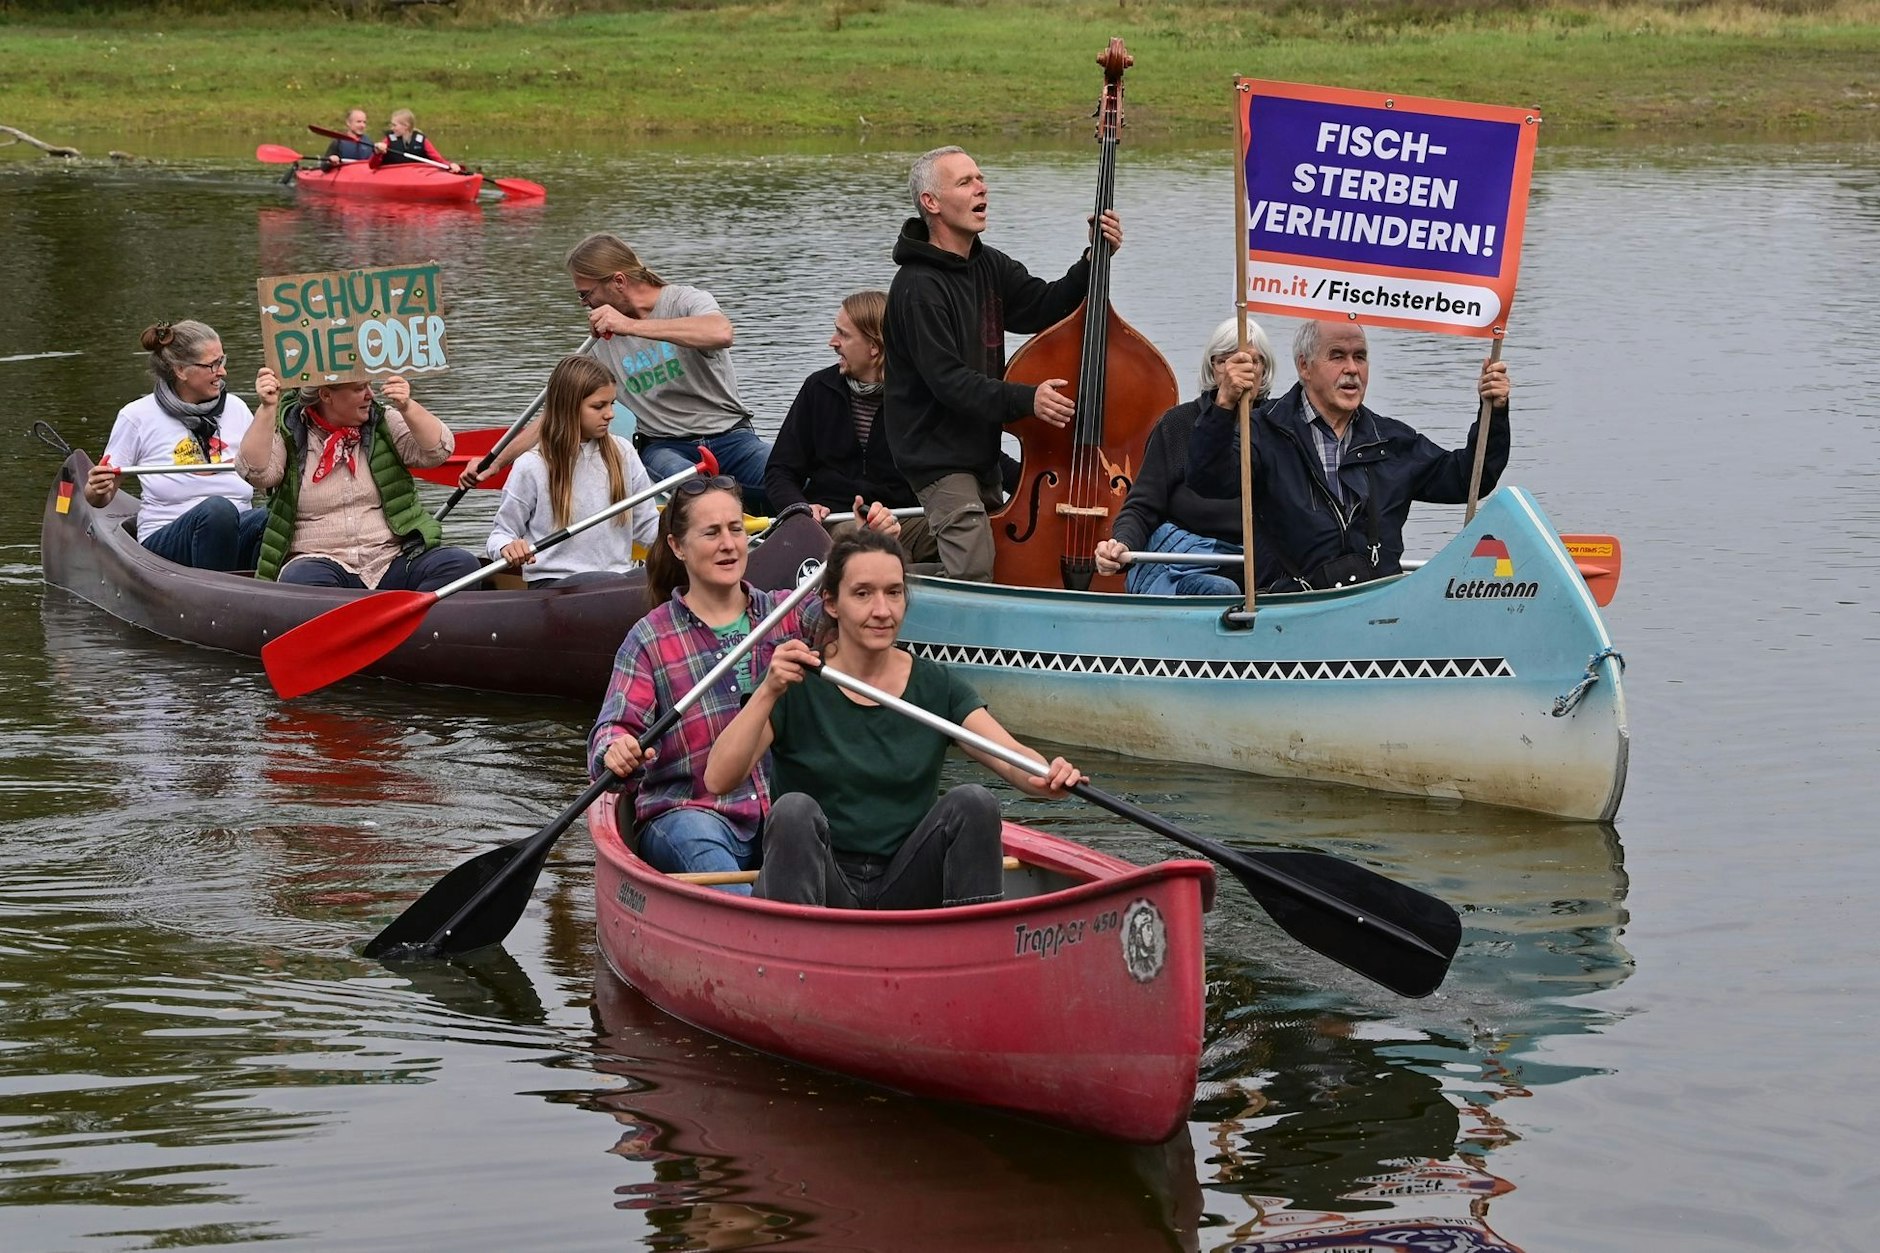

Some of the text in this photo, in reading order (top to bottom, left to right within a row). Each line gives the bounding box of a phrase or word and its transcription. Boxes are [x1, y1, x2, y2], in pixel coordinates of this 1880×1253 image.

[1315, 121, 1448, 164] FISCH-
[1291, 163, 1459, 210] STERBEN
[1247, 199, 1497, 258] VERHINDERN!
[272, 265, 441, 324] SCHÜTZT
[1248, 275, 1308, 298] nn.it
[274, 315, 447, 379] DIE ODER
[625, 358, 685, 394] ODER
[1444, 577, 1539, 600] Lettmann
[1015, 911, 1118, 958] Trapper 450
